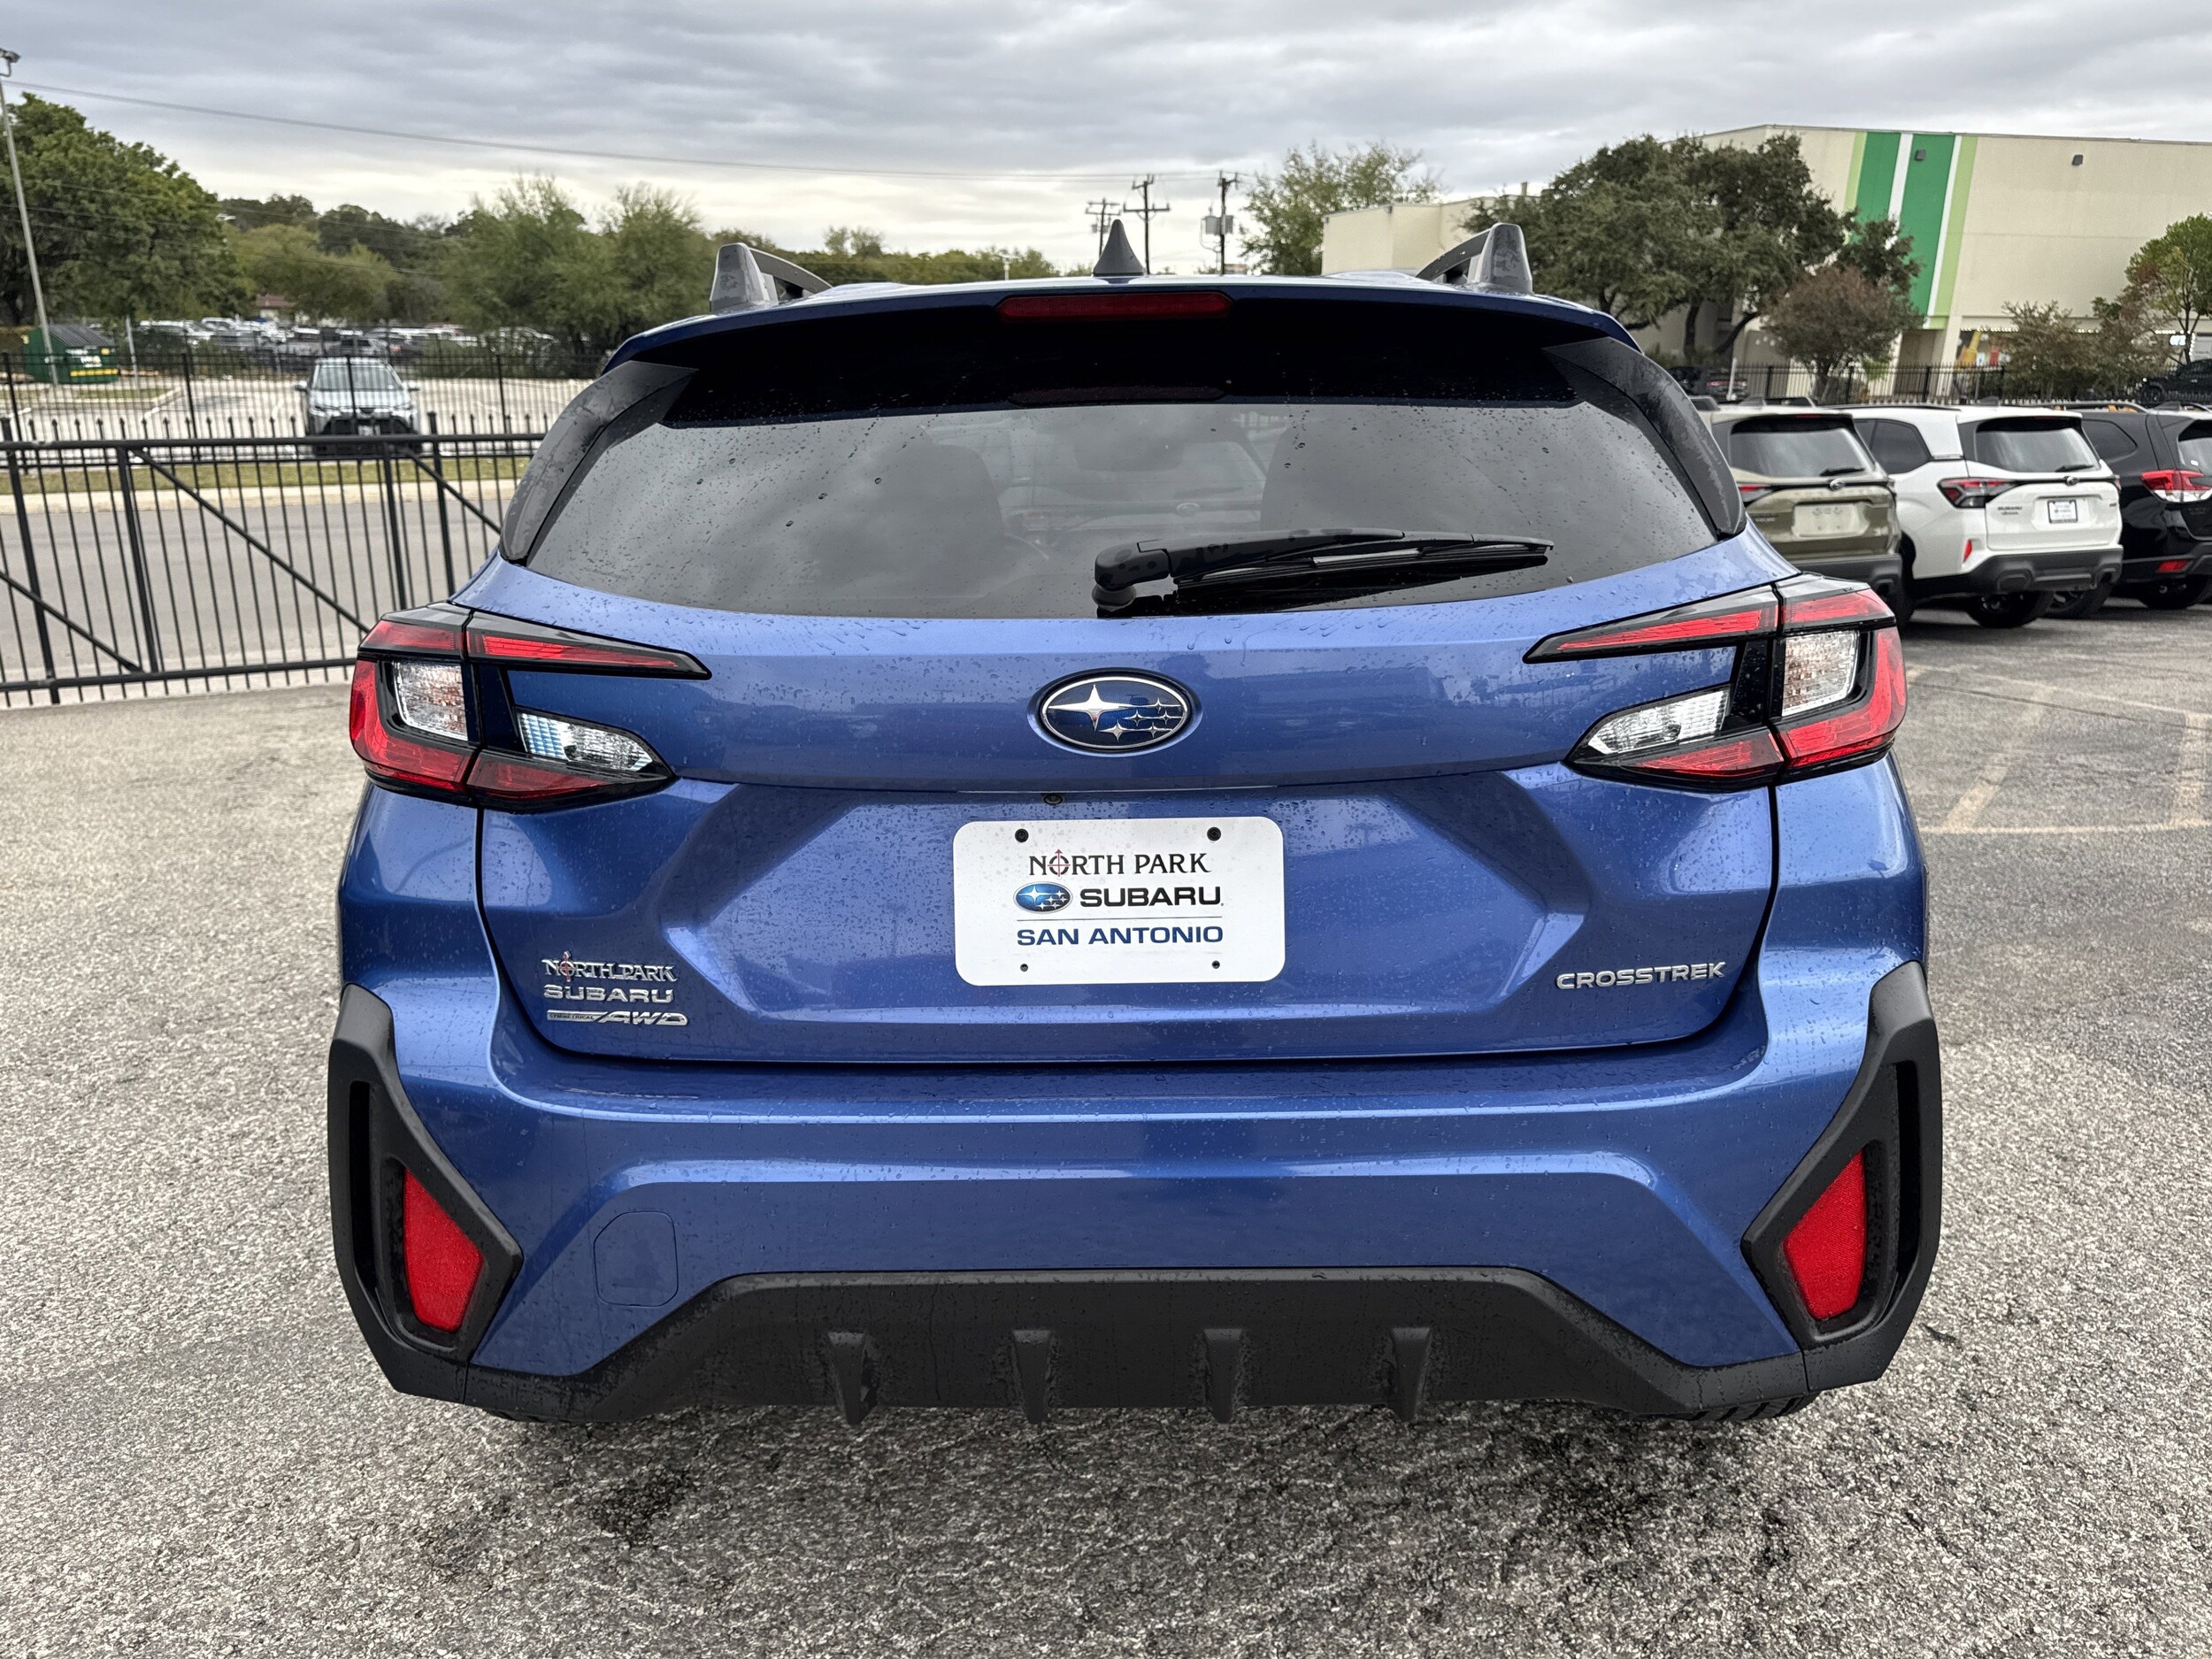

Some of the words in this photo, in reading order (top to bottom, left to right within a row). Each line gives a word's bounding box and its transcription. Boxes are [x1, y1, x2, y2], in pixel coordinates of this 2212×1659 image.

[1028, 851, 1125, 876] NORTH
[1134, 852, 1211, 874] PARK
[1079, 886, 1221, 908] SUBARU
[1017, 928, 1079, 946] SAN
[1088, 926, 1224, 945] ANTONIO
[541, 957, 615, 980] NORTH
[618, 964, 678, 982] PARK
[1556, 961, 1725, 990] CROSSTREK
[543, 984, 674, 1003] SUBARU
[598, 1010, 687, 1026] AWD
